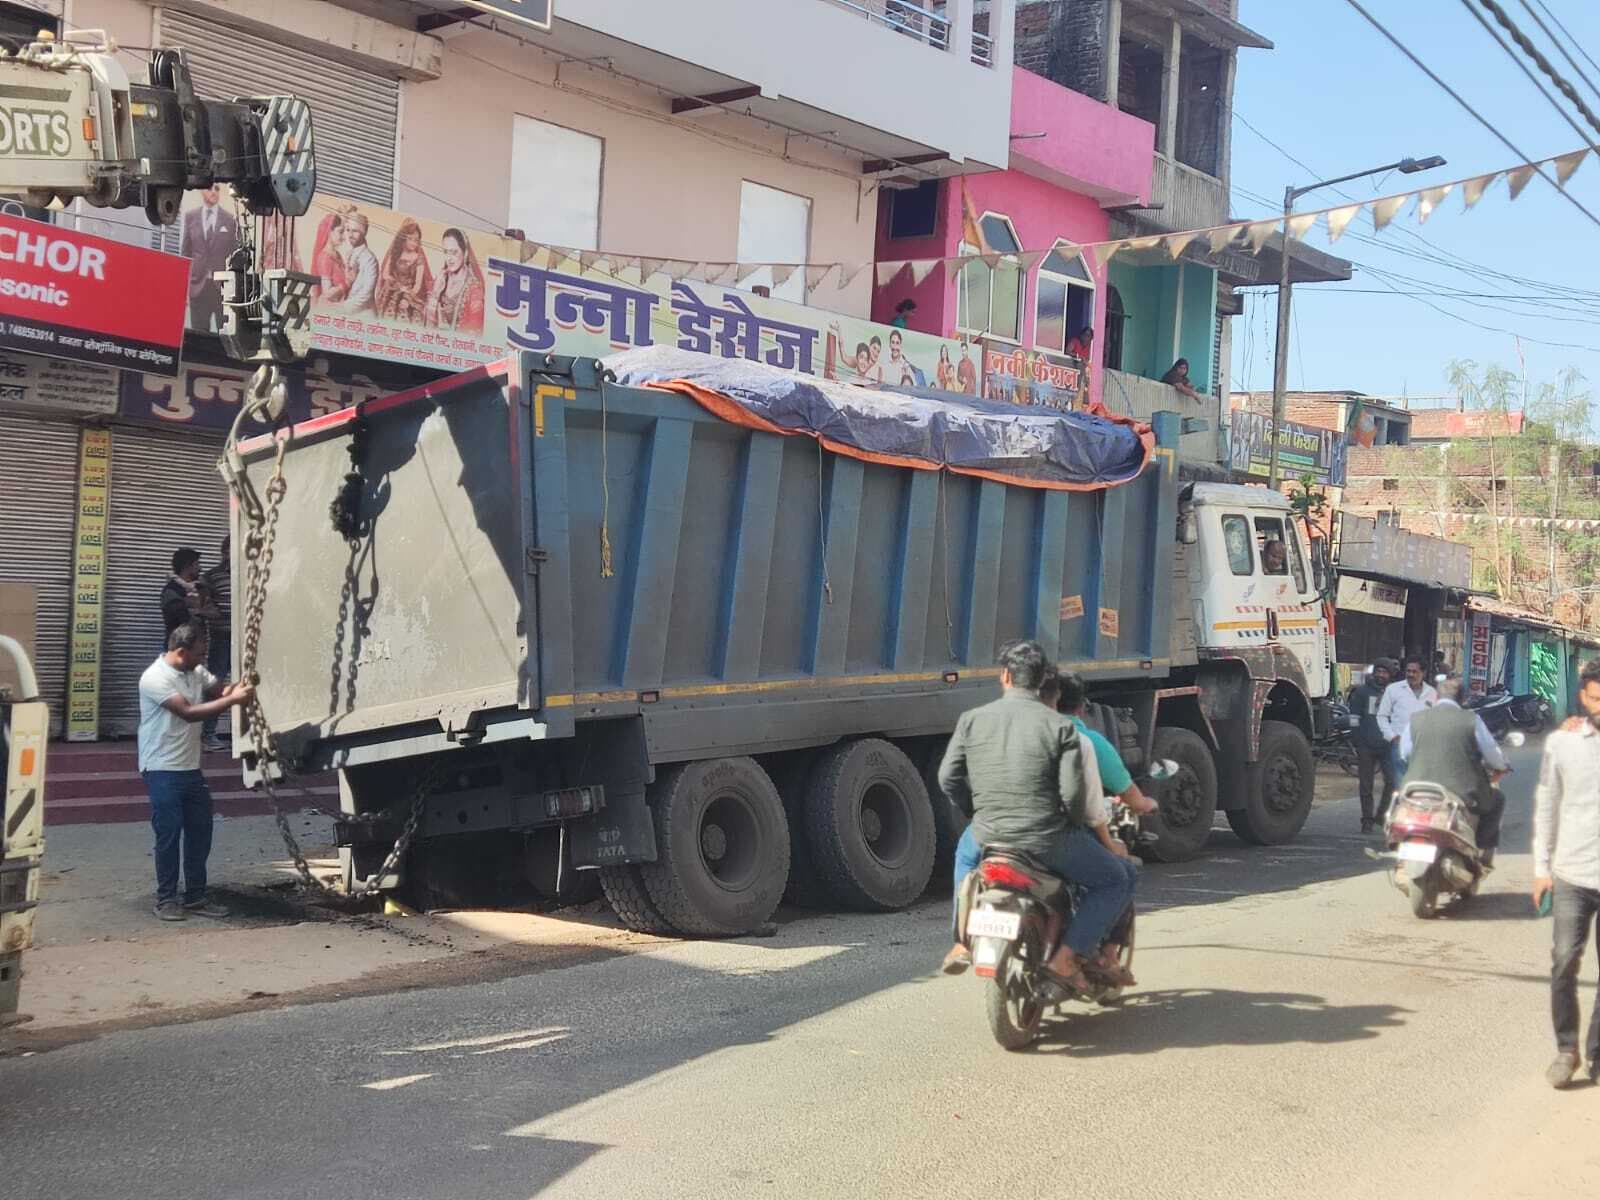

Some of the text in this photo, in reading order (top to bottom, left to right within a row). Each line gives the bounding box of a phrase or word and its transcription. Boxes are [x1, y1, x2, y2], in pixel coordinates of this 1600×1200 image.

[0, 277, 69, 307] sonic
[487, 256, 661, 353] मुन्ना
[597, 844, 626, 858] TATA
